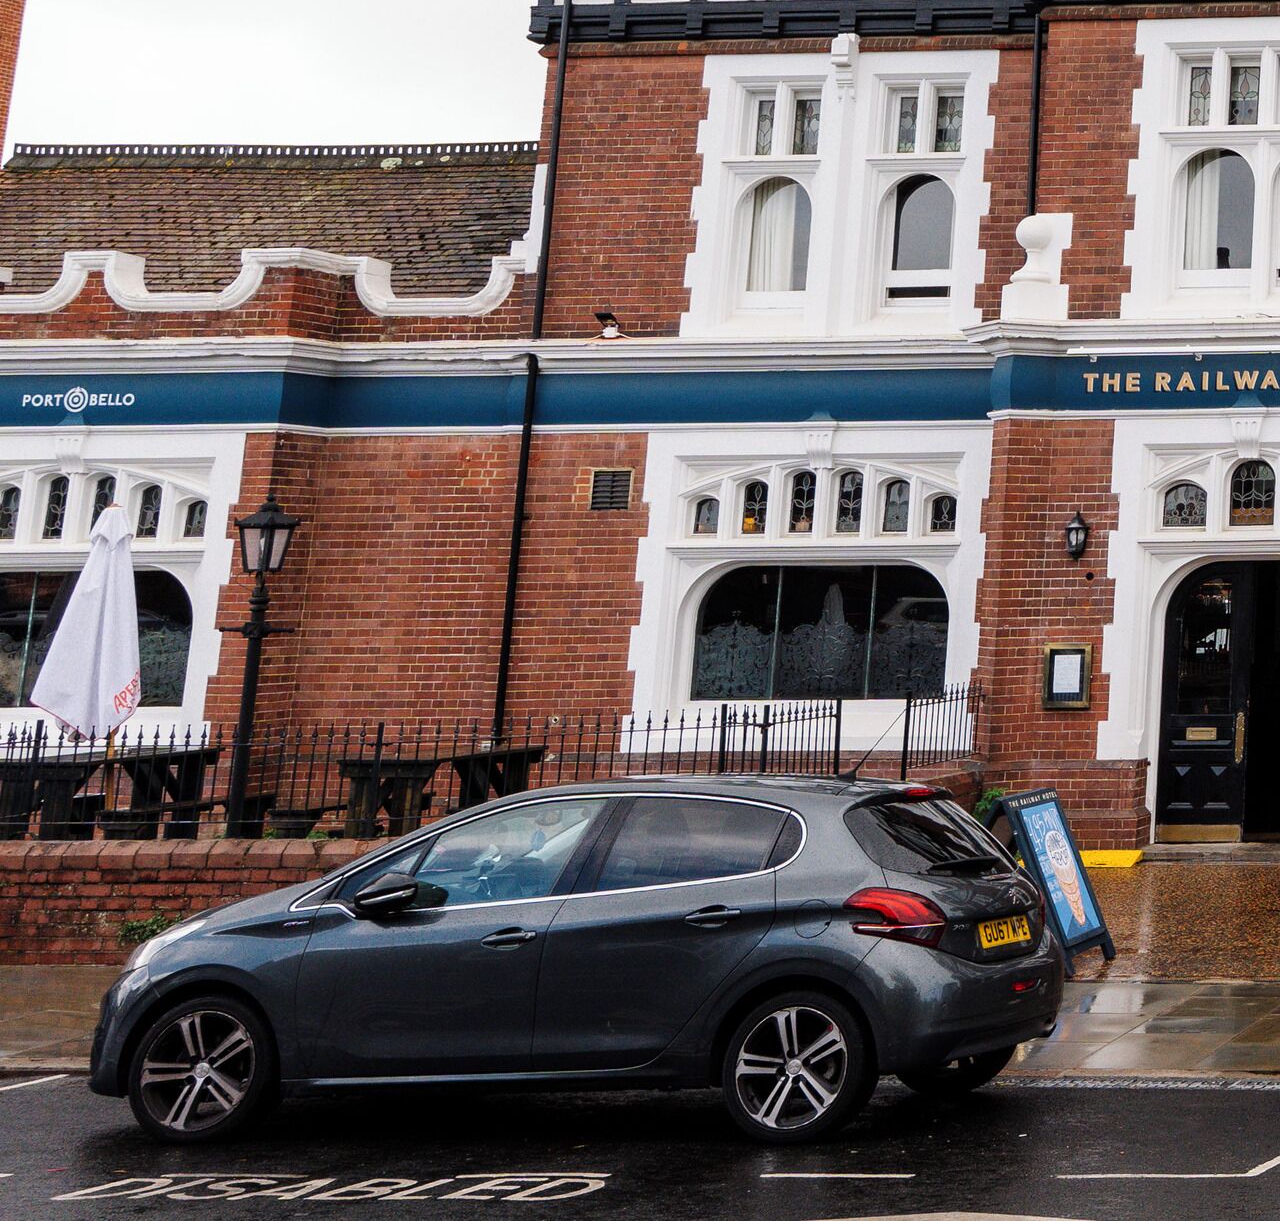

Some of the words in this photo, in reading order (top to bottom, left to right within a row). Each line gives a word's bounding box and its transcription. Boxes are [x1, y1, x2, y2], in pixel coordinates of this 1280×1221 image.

[1083, 372, 1141, 393] THE
[114, 669, 141, 715] APER
[1008, 799, 1019, 808] THE
[1020, 795, 1041, 806] RAILWAY
[1042, 791, 1058, 800] HOTEL
[983, 920, 1010, 943] GU67
[51, 1177, 607, 1201] DISABLED
